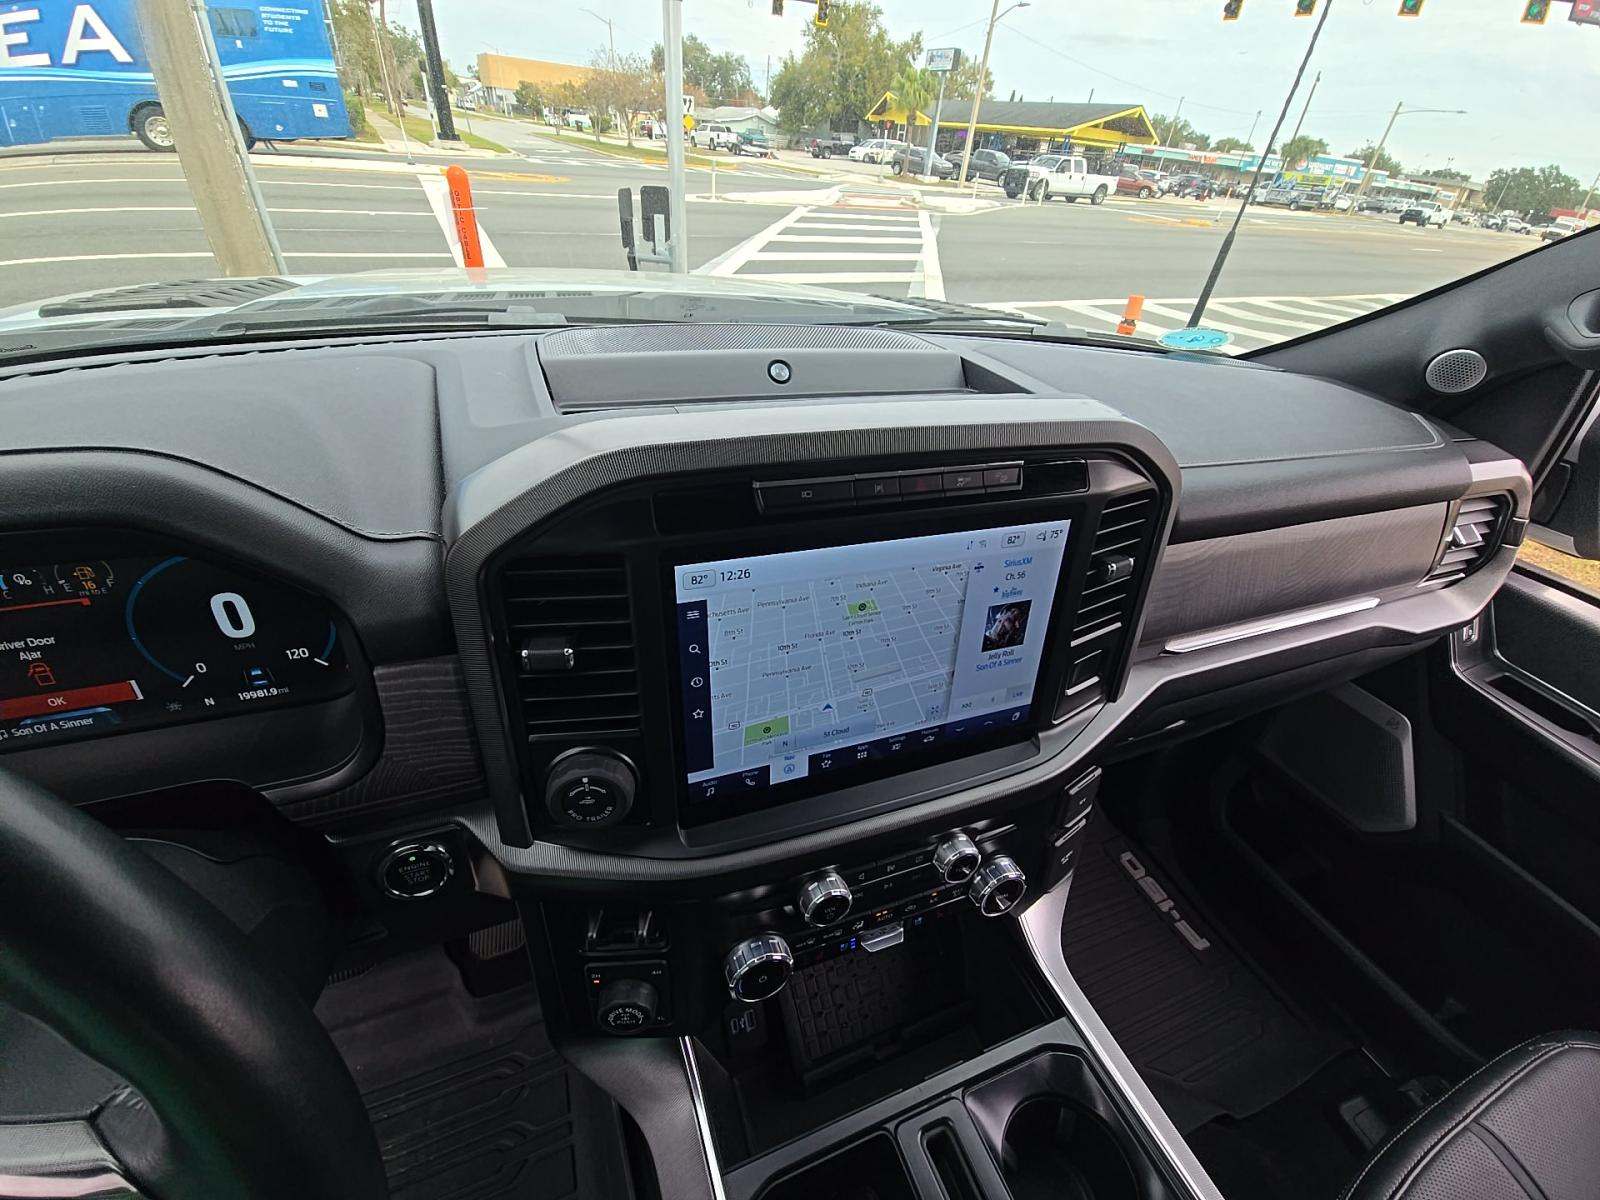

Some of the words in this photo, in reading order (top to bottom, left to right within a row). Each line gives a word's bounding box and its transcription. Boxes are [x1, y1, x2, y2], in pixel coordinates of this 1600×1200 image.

[259, 6, 309, 15] CONNECTING
[261, 13, 301, 21] STUDENTS
[264, 26, 294, 34] FUTURE
[1003, 556, 1033, 568] SiriusXM
[691, 574, 709, 585] 82°
[720, 568, 751, 582] 12:26
[82, 580, 97, 591] 16
[798, 594, 810, 602] Ave
[210, 592, 256, 639] 0
[0, 641, 25, 651] river
[27, 637, 56, 647] Door
[20, 651, 42, 661] Ajar
[286, 647, 310, 660] 120
[1001, 649, 1015, 658] Roll
[195, 662, 207, 674] 0
[976, 663, 989, 672] Son
[1003, 656, 1023, 667] Sinner
[238, 687, 278, 701] 19981.9
[47, 697, 67, 707] OK
[204, 697, 216, 706] N
[11, 727, 34, 737] Son
[33, 724, 48, 733] Of
[50, 722, 60, 731] A
[60, 717, 94, 729] Sinner
[831, 726, 850, 737] Cloud
[585, 806, 613, 822] TRAILER
